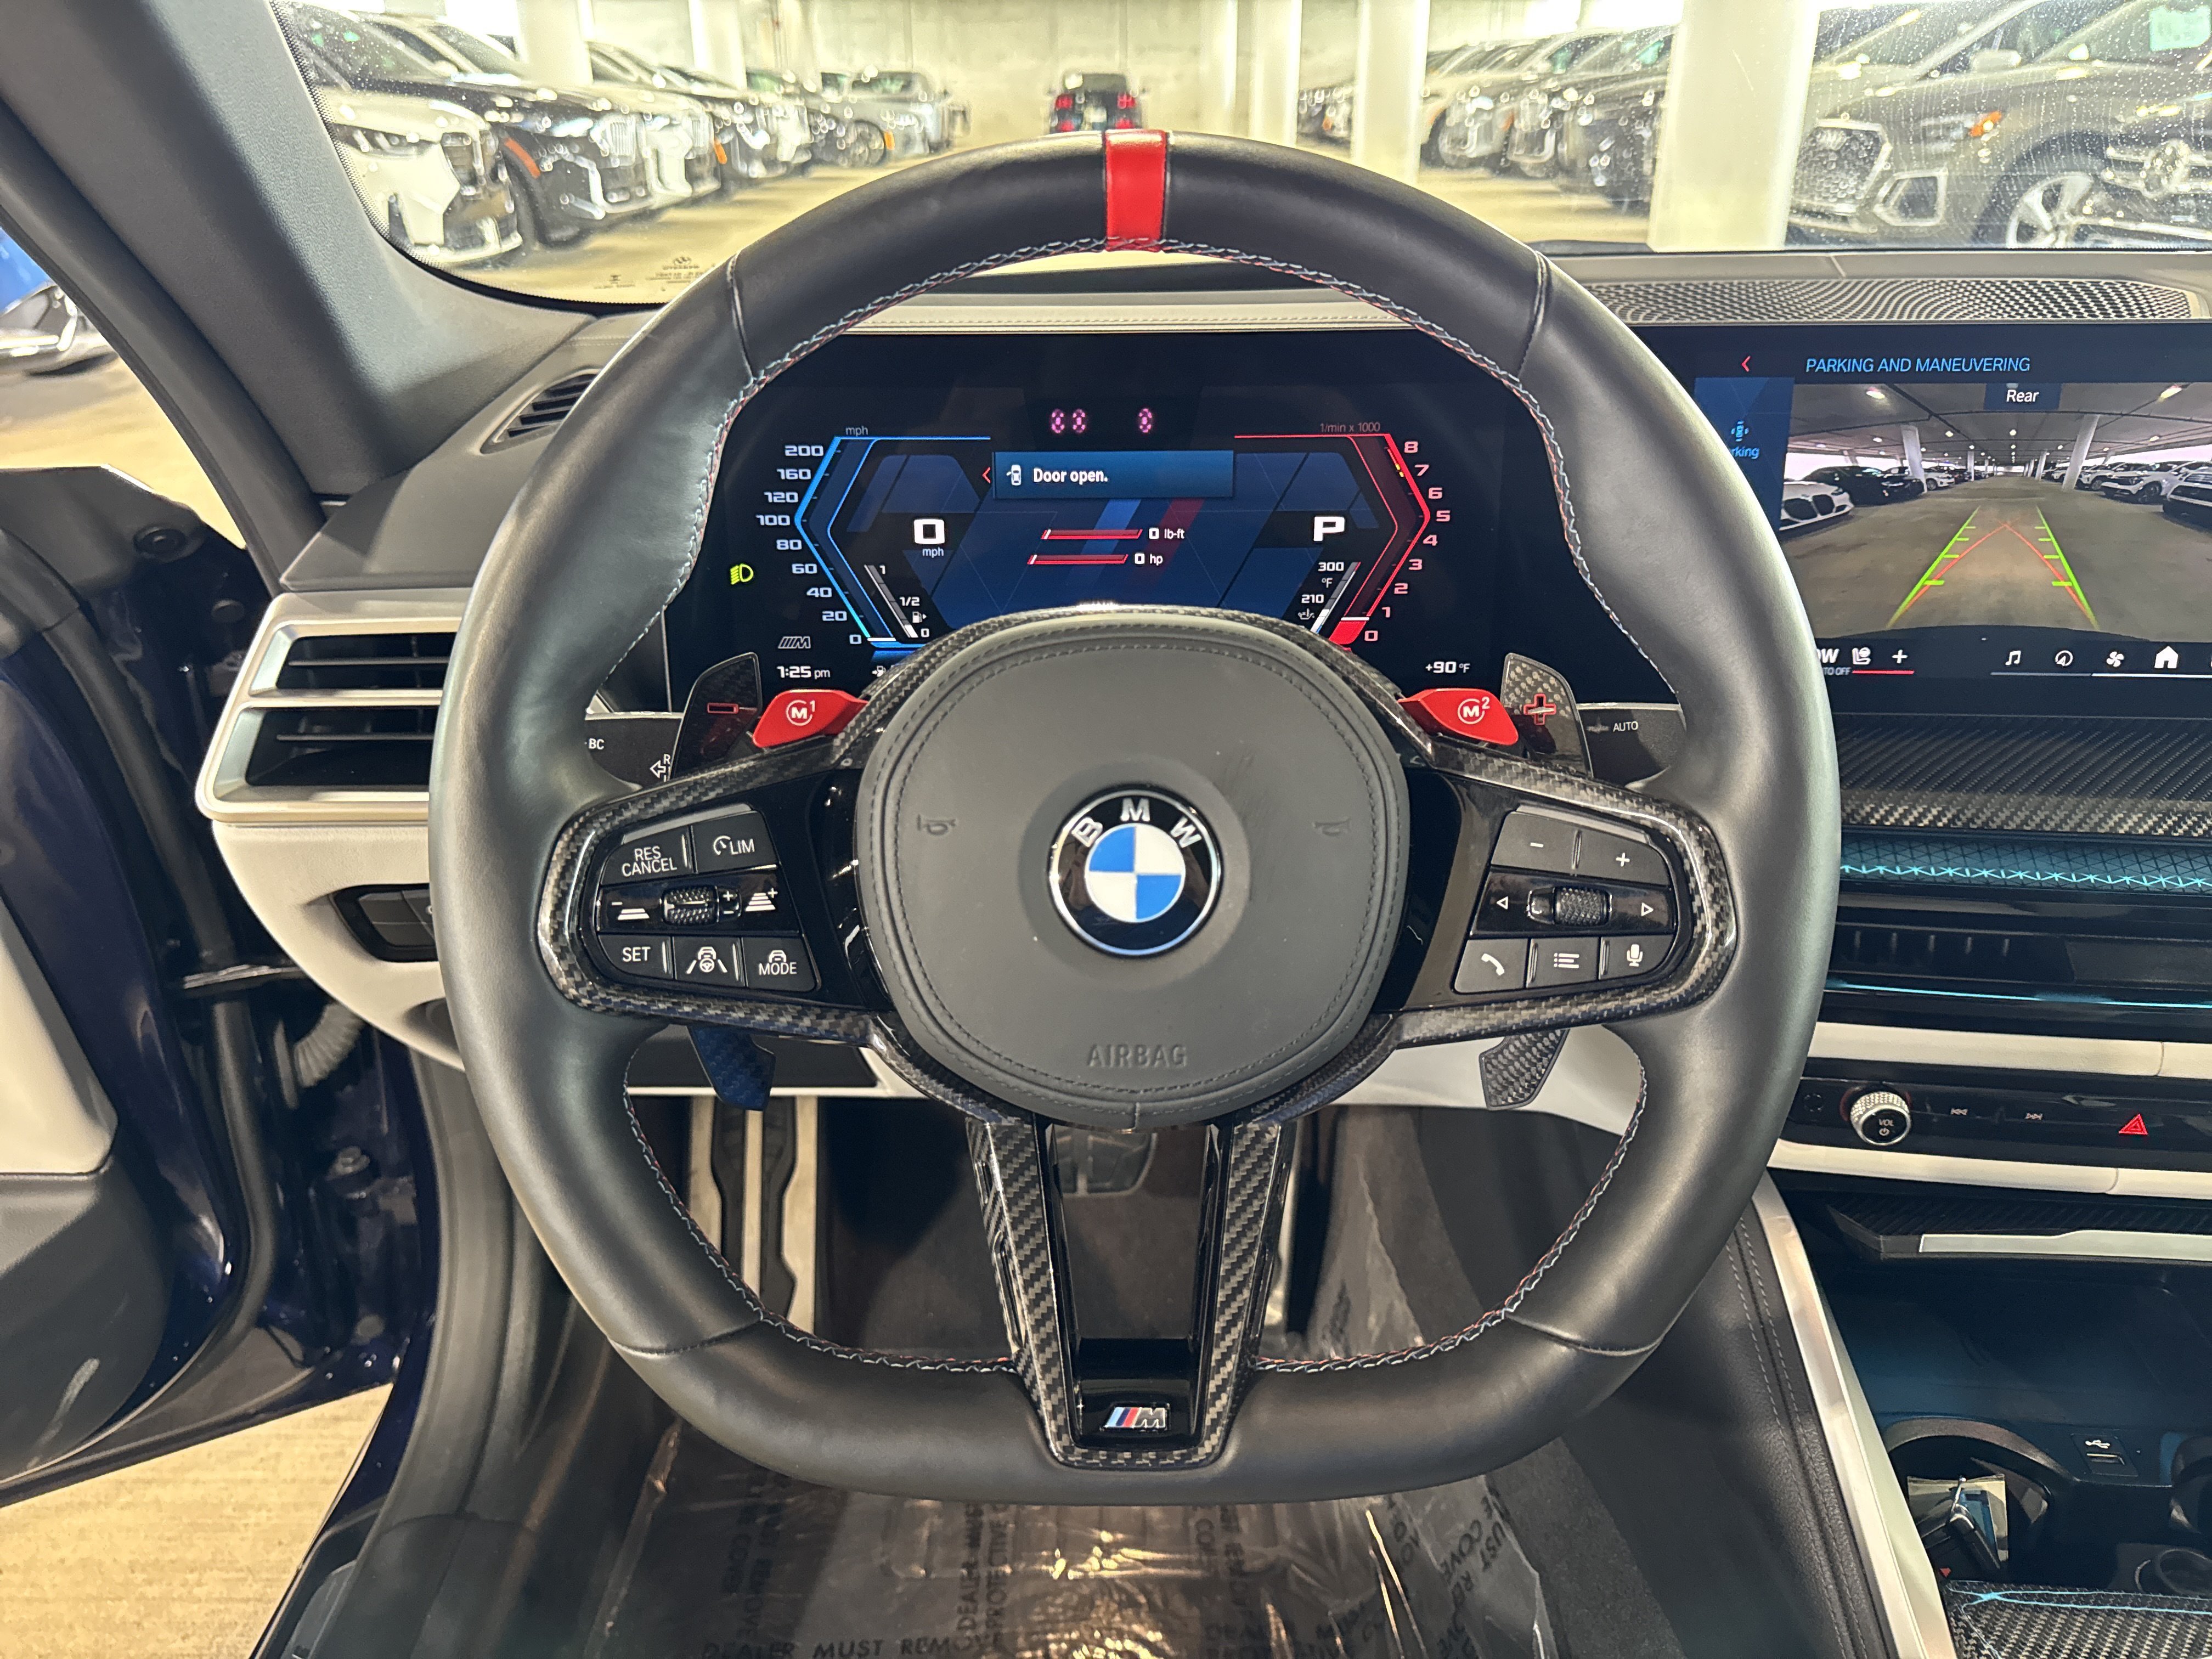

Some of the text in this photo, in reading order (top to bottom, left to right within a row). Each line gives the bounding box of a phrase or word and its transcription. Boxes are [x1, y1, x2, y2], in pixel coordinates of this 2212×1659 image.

[1806, 357, 2030, 373] PARKING AND MANEUVERING
[2006, 389, 2040, 402] Rear
[845, 426, 869, 436] mph
[1320, 423, 1346, 432] 1/min
[1358, 421, 1380, 432] 1000
[785, 445, 824, 457] 200
[1404, 441, 1418, 453] 8
[1730, 445, 1760, 460] rking
[776, 469, 811, 480] 160
[1414, 464, 1429, 476] 7
[1033, 469, 1108, 486] Door open.
[764, 492, 799, 503] 120
[1428, 487, 1442, 499] 6
[756, 515, 791, 526] 100
[1436, 510, 1451, 522] 5
[913, 518, 945, 545] 0
[1148, 528, 1185, 540] 0 lb-ft
[1313, 516, 1345, 541] P
[776, 539, 802, 550] 80
[1422, 534, 1438, 546] 4
[922, 547, 944, 558] mph
[1134, 552, 1163, 566] 0 hp
[1408, 558, 1423, 571] 3
[791, 563, 817, 574] 60
[879, 565, 886, 575] 1
[1318, 561, 1345, 572] 300
[806, 587, 832, 598] 40
[1394, 583, 1408, 594] 2
[899, 596, 921, 606] 1/2
[1301, 594, 1324, 603] 210
[822, 611, 848, 622] 20
[1381, 606, 1391, 618] 1
[921, 628, 930, 637] 0
[1364, 630, 1379, 641] 0
[849, 634, 862, 645] 0
[776, 665, 831, 680] 1:25 pm
[1824, 667, 1852, 676] TO OFF
[1613, 720, 1639, 732] AUTO
[589, 738, 605, 750] BC
[663, 753, 671, 765] R
[1071, 797, 1203, 849] BMW
[634, 845, 661, 861] RES
[730, 839, 755, 855] LIM
[622, 857, 678, 877] CANCEL
[622, 946, 651, 962] SET
[759, 962, 797, 975] MODE
[1086, 1044, 1189, 1069] AIRBAG
[1879, 1119, 1894, 1127] VOL
[813, 1639, 884, 1659] MUST
